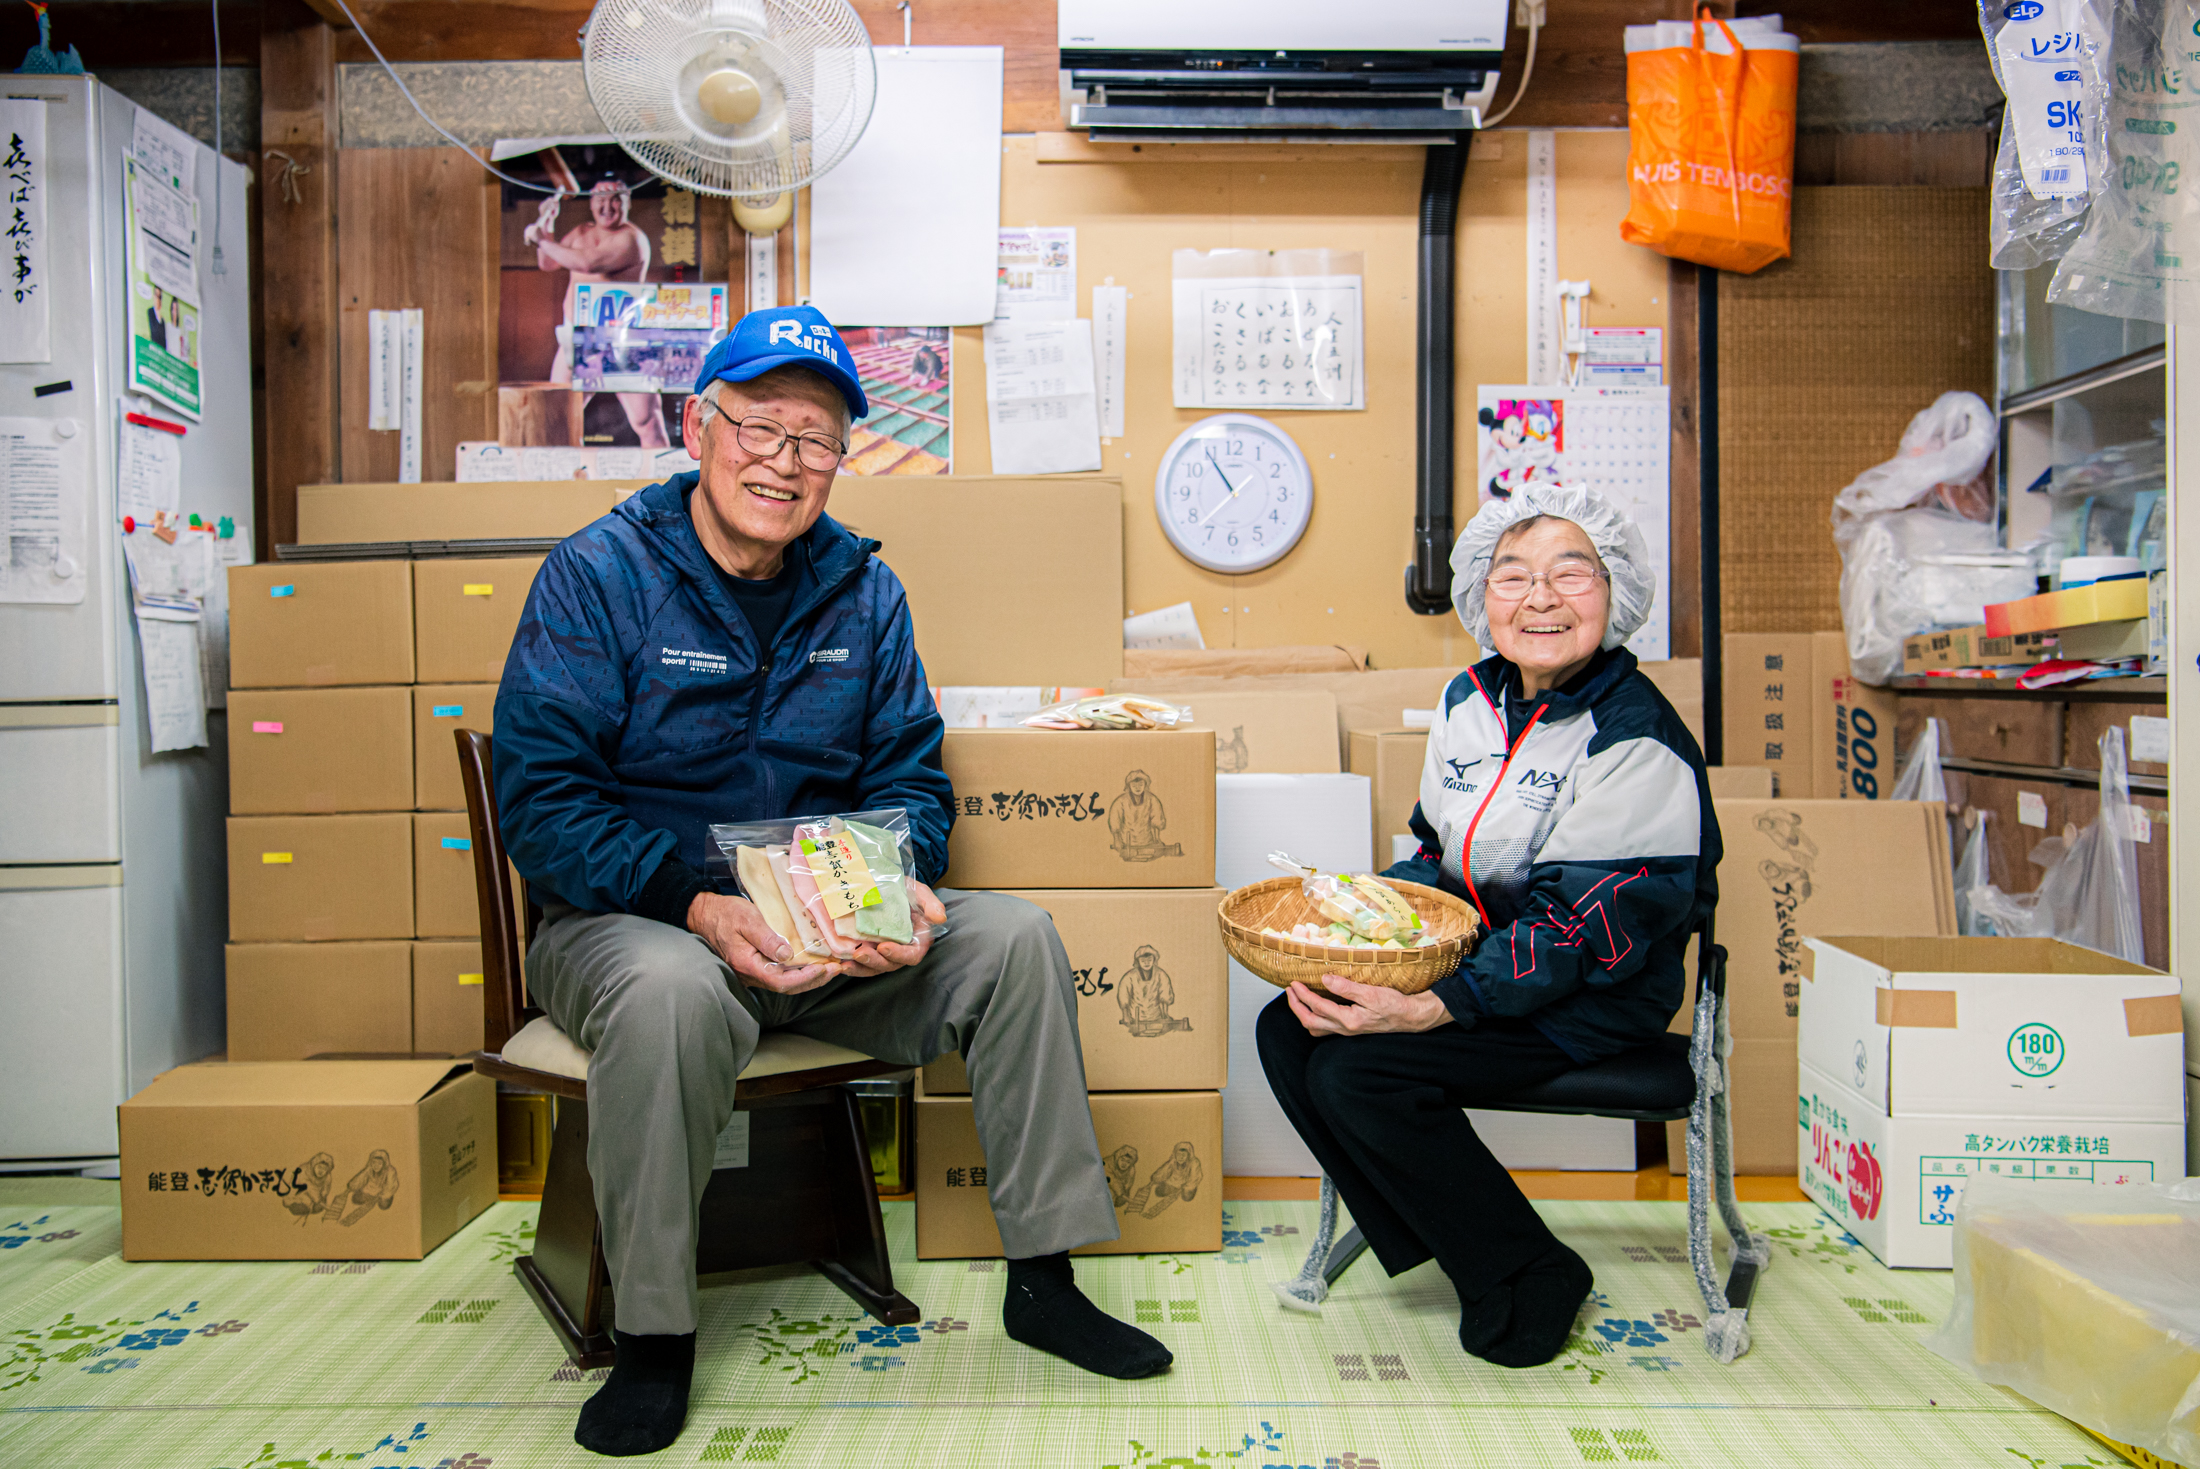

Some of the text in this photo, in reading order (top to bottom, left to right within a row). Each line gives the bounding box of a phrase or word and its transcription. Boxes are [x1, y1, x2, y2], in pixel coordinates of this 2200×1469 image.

[2009, 4, 2040, 18] ELP
[642, 304, 710, 320] カードケース
[1204, 446, 1217, 461] 11
[1225, 441, 1243, 456] 12
[1255, 446, 1261, 461] 1
[1186, 463, 1203, 478] 10
[1270, 463, 1280, 478] 2
[1179, 486, 1191, 501] 9
[1276, 487, 1288, 502] 3
[1188, 508, 1198, 523] 8
[1268, 509, 1279, 524] 4
[1205, 526, 1215, 541] 7
[1227, 531, 1239, 547] 6
[1252, 526, 1263, 542] 5
[661, 657, 687, 666] sportif
[662, 647, 727, 662] Pour entraînement
[1765, 653, 1783, 760] 取扱注意
[1851, 708, 1878, 799] 800
[1442, 776, 1478, 793] MIZUNO
[988, 789, 1106, 822] 志賀かきもち
[825, 850, 860, 910] 志賀かきもち
[2016, 1033, 2055, 1055] 180
[1964, 1134, 2110, 1155] 高タンパク栄養栽培
[1813, 1122, 1847, 1185] りんご
[1931, 1163, 1967, 1173] 品名
[1989, 1164, 2024, 1175] 等級
[148, 1166, 308, 1197] 能登 志賀かきもち
[946, 1167, 987, 1188] 能登
[1932, 1184, 1964, 1203] サ
